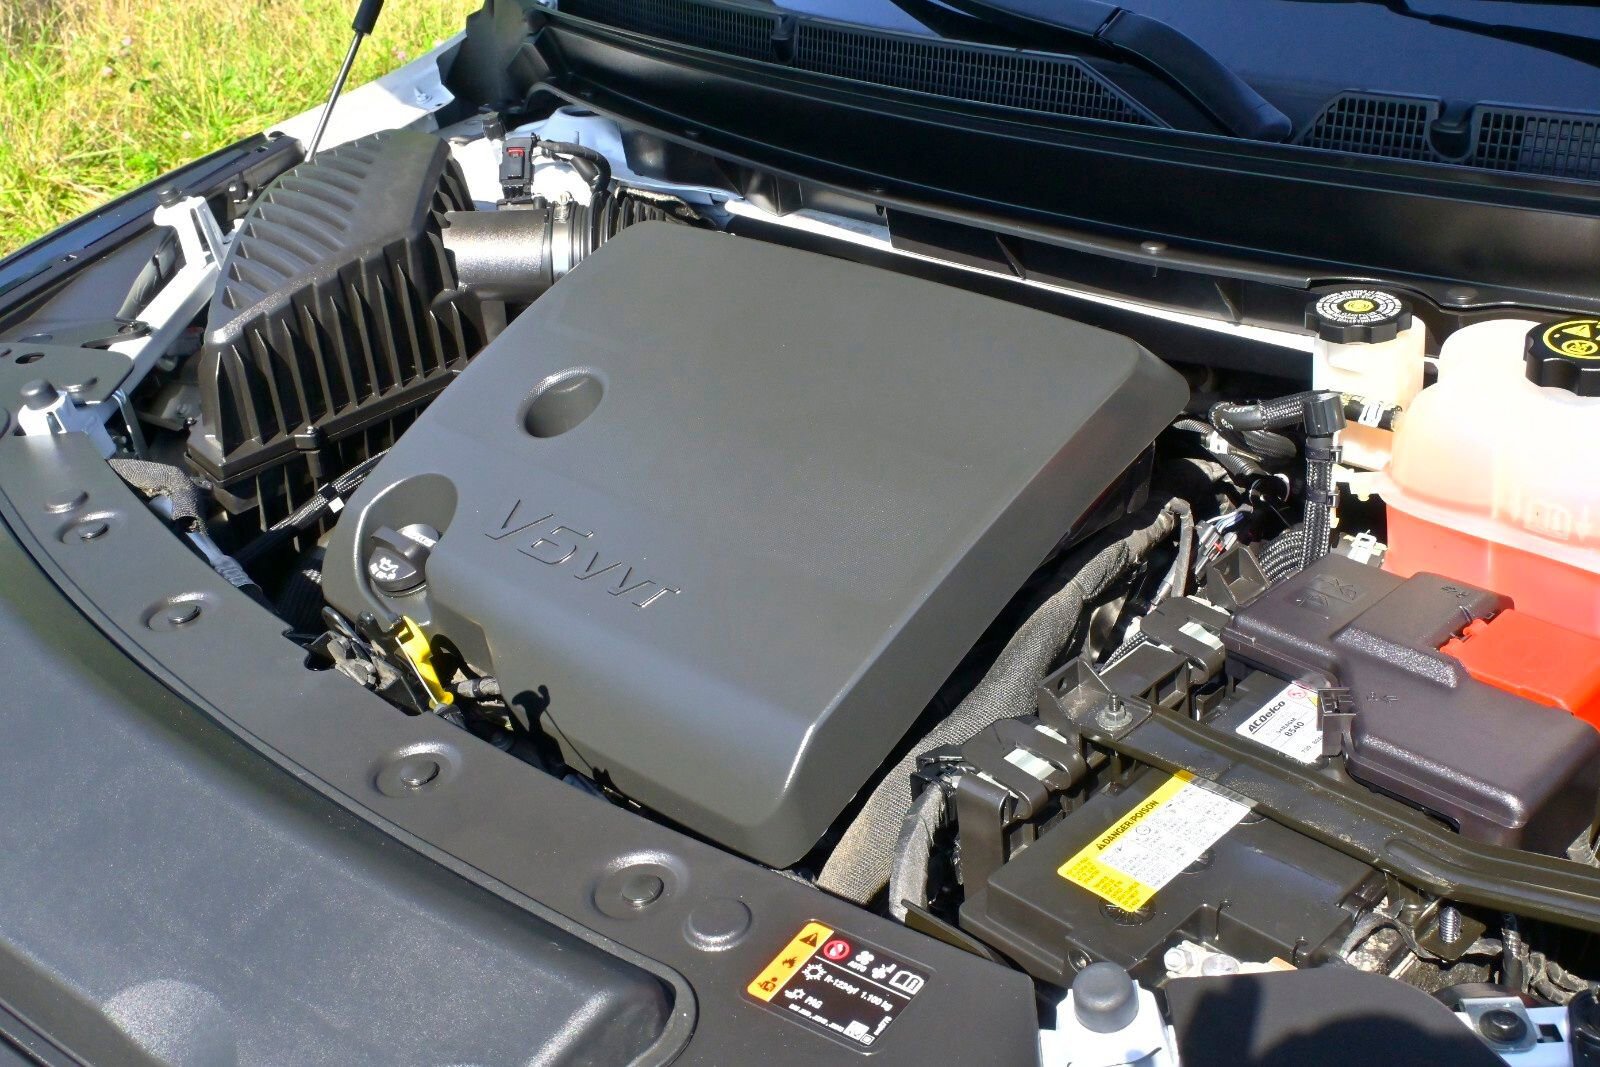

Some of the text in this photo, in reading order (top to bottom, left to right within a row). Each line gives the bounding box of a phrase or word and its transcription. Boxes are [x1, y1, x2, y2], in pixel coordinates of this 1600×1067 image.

[1248, 700, 1286, 733] ACDelco
[1284, 721, 1305, 737] 8540
[1103, 799, 1160, 846] DANGER/POISON
[804, 995, 824, 1010] PAG
